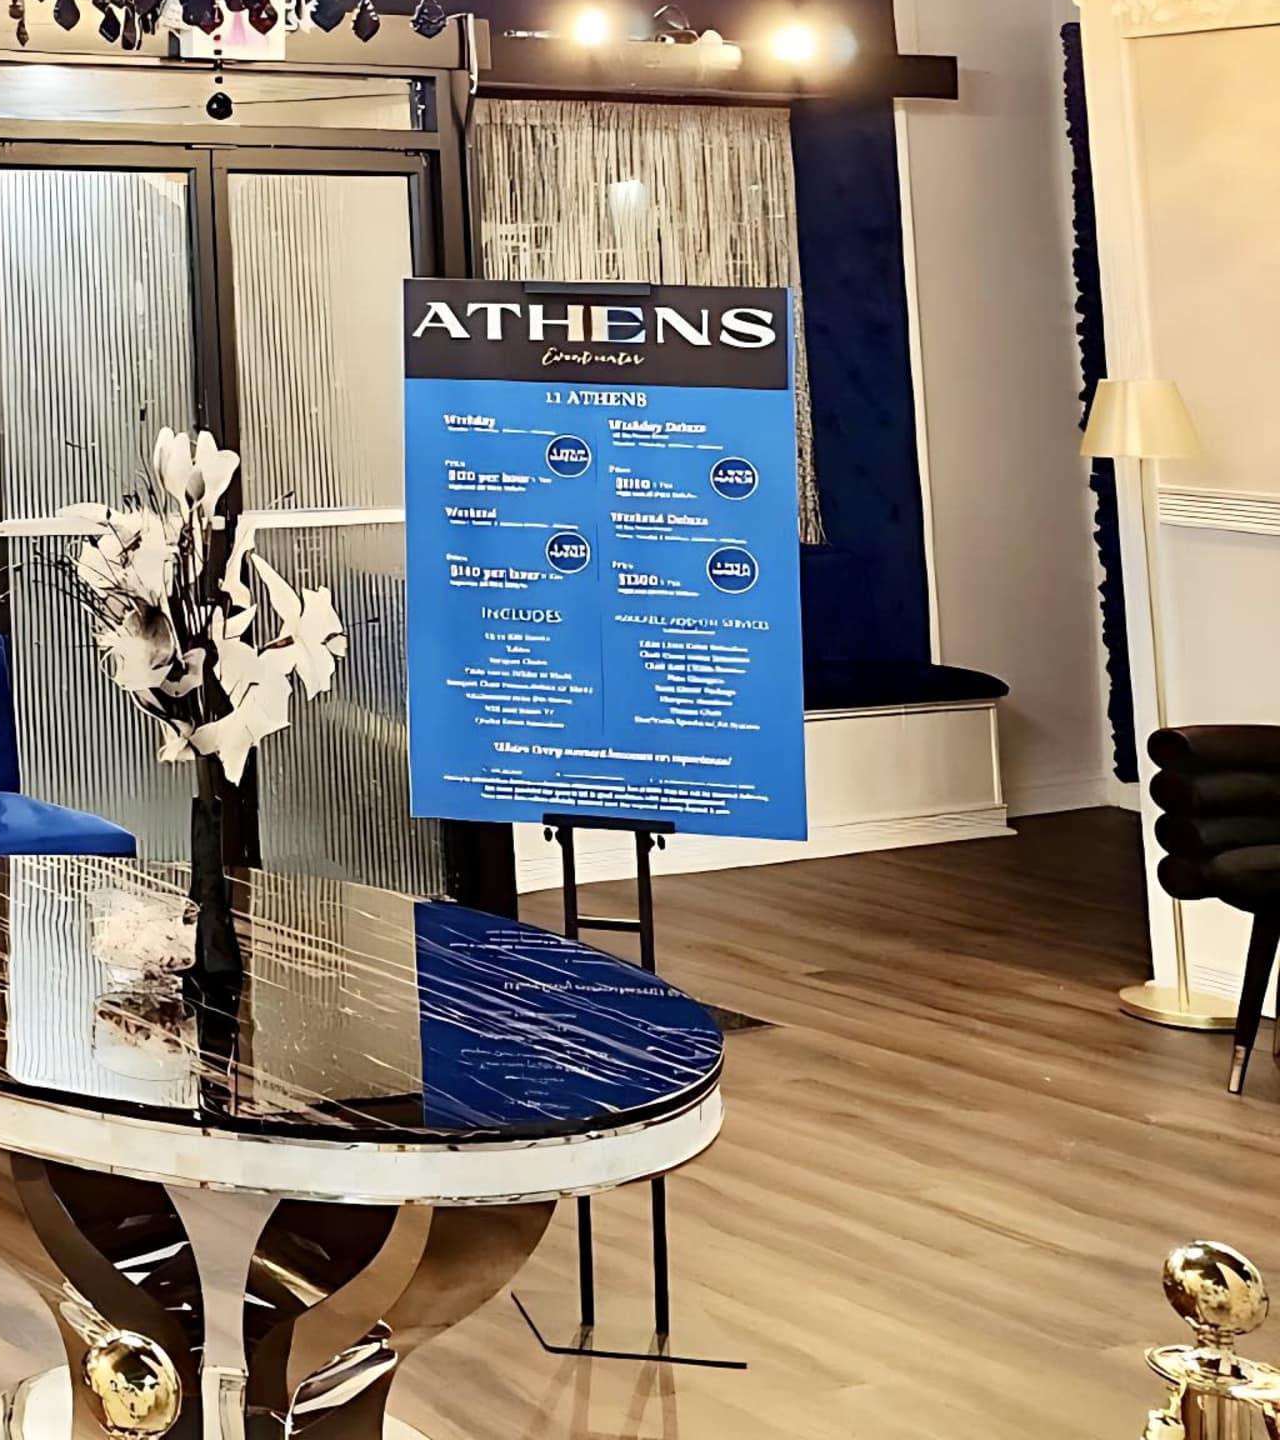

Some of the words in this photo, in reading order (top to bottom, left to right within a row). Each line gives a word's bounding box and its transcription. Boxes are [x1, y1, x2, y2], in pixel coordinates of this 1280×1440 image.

[412, 302, 776, 348] ATHENS
[567, 391, 648, 407] ATHENS
[482, 607, 562, 623] INCLUDES
